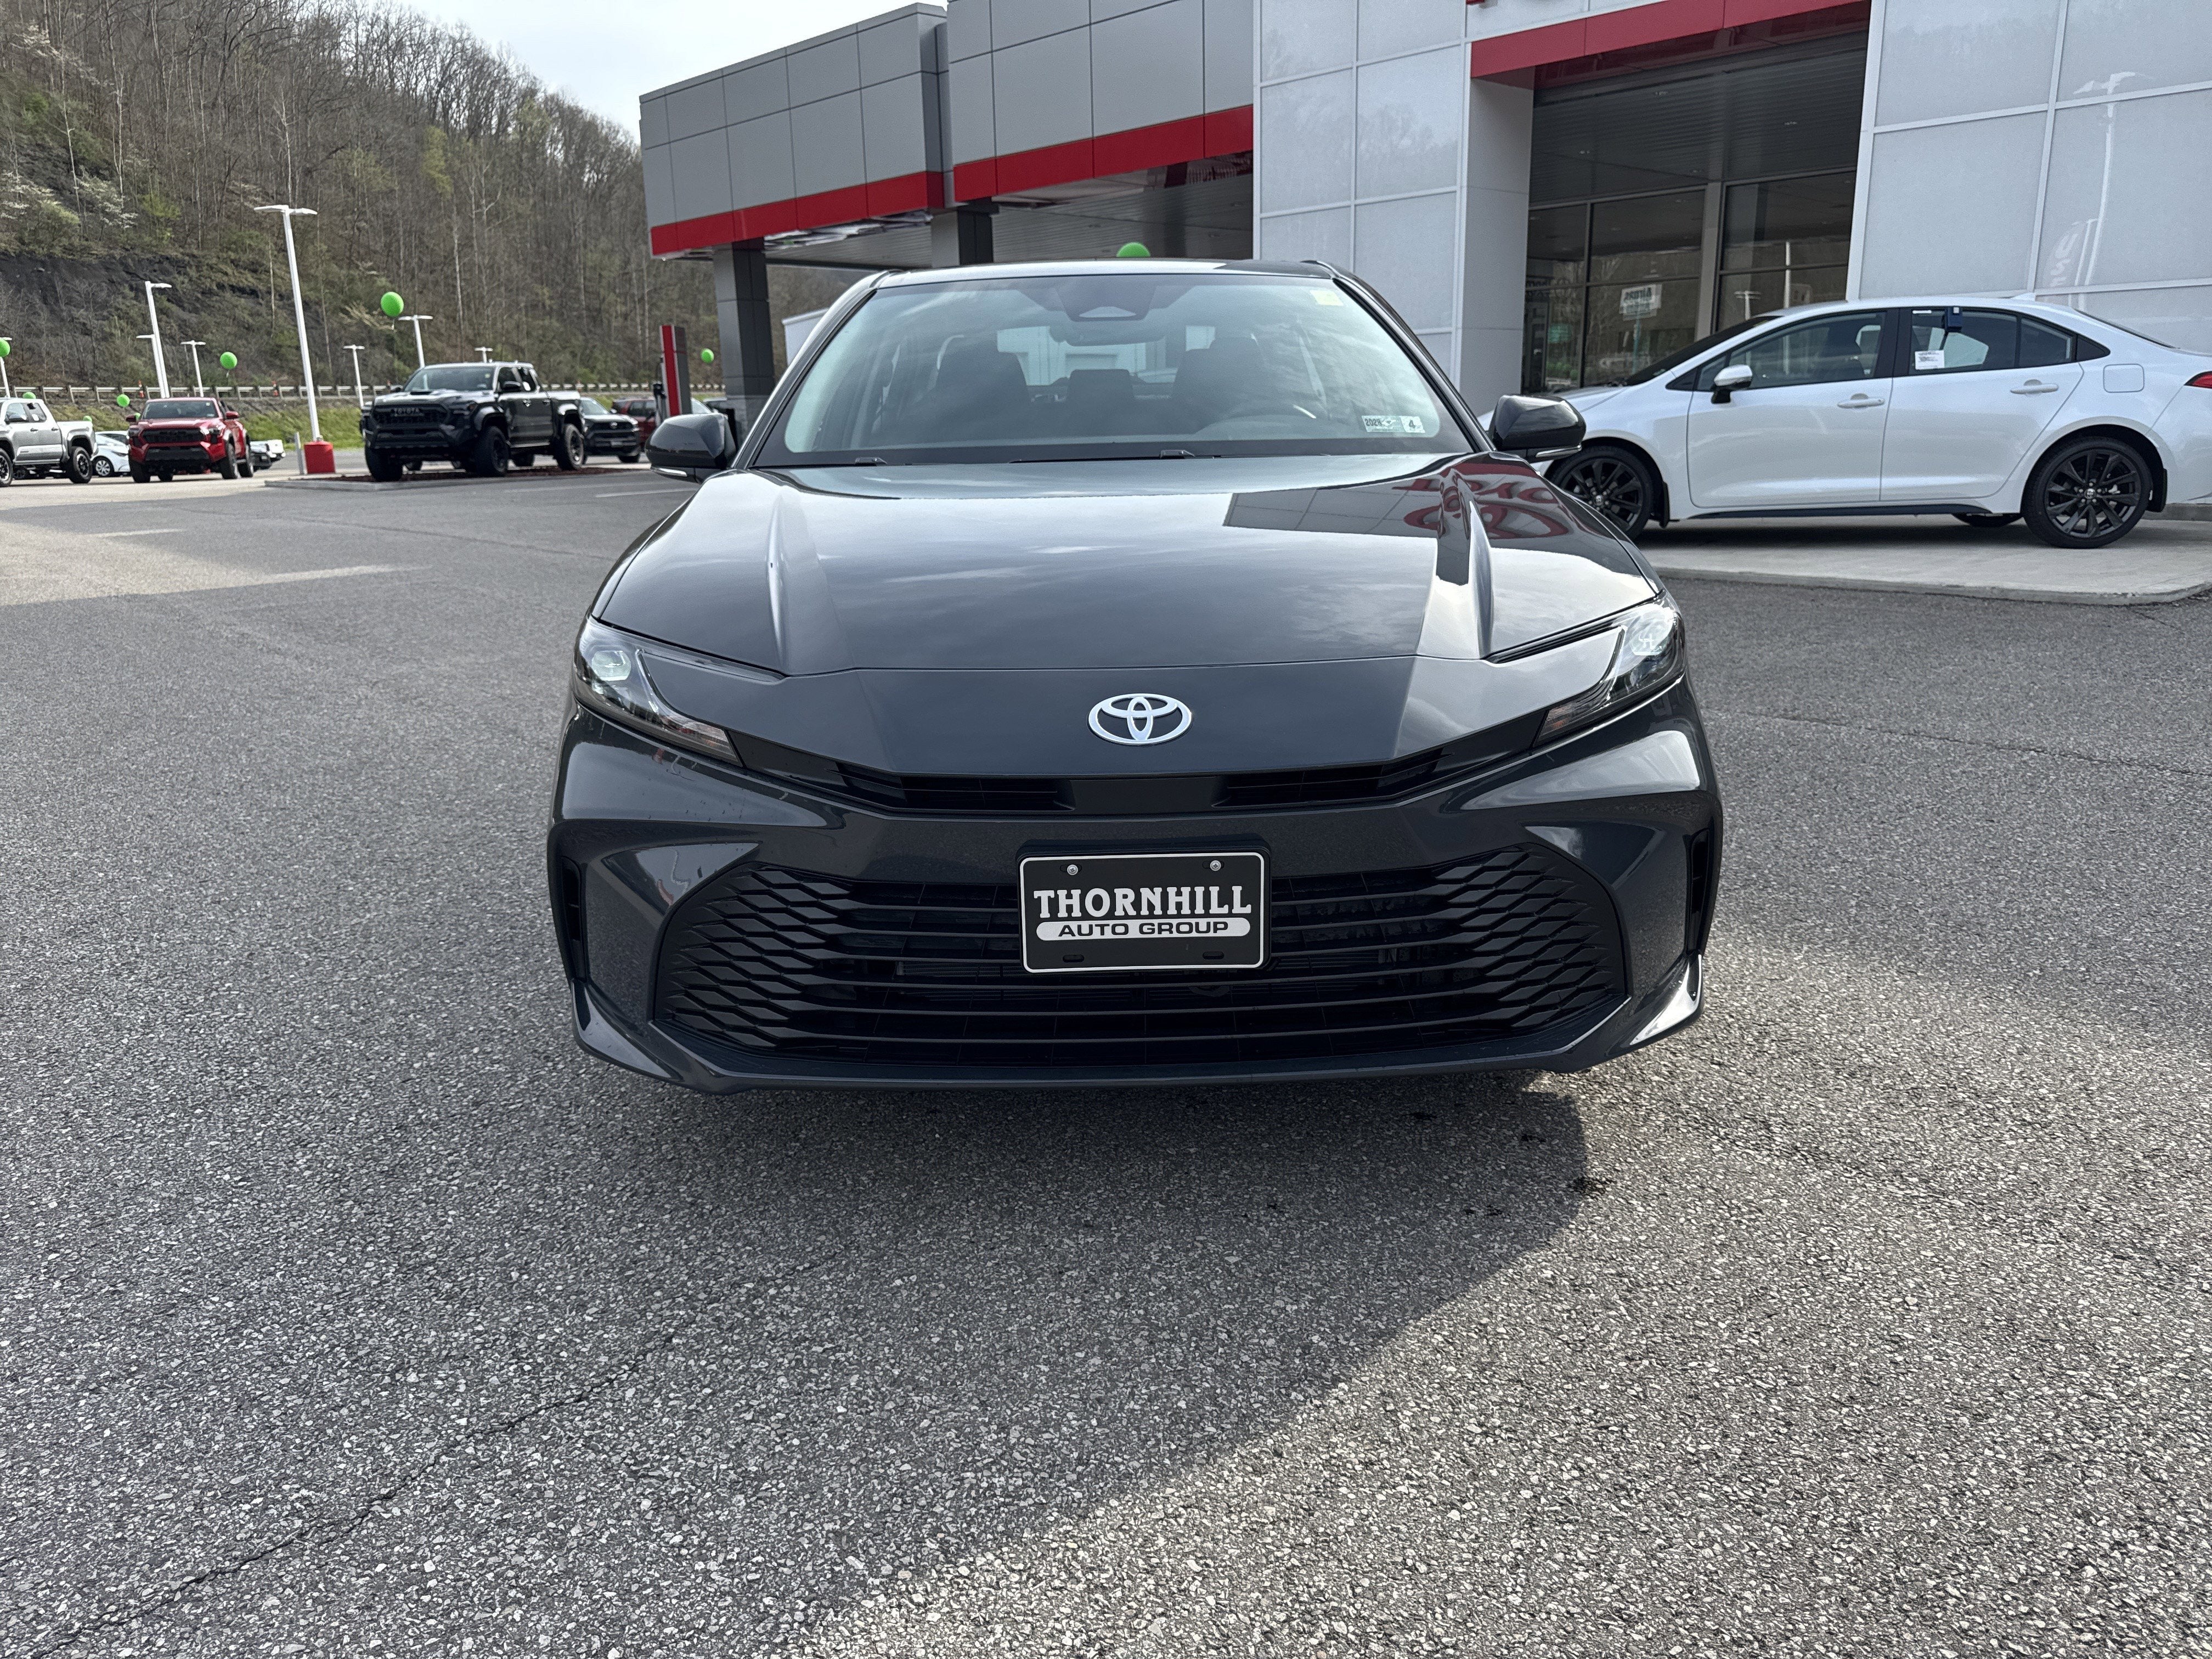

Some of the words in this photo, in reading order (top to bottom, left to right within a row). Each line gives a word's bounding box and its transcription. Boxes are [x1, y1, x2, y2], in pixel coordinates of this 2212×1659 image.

[1034, 885, 1251, 918] THORNHILL
[1058, 923, 1129, 937] AUTO
[1138, 921, 1228, 935] GROUP
